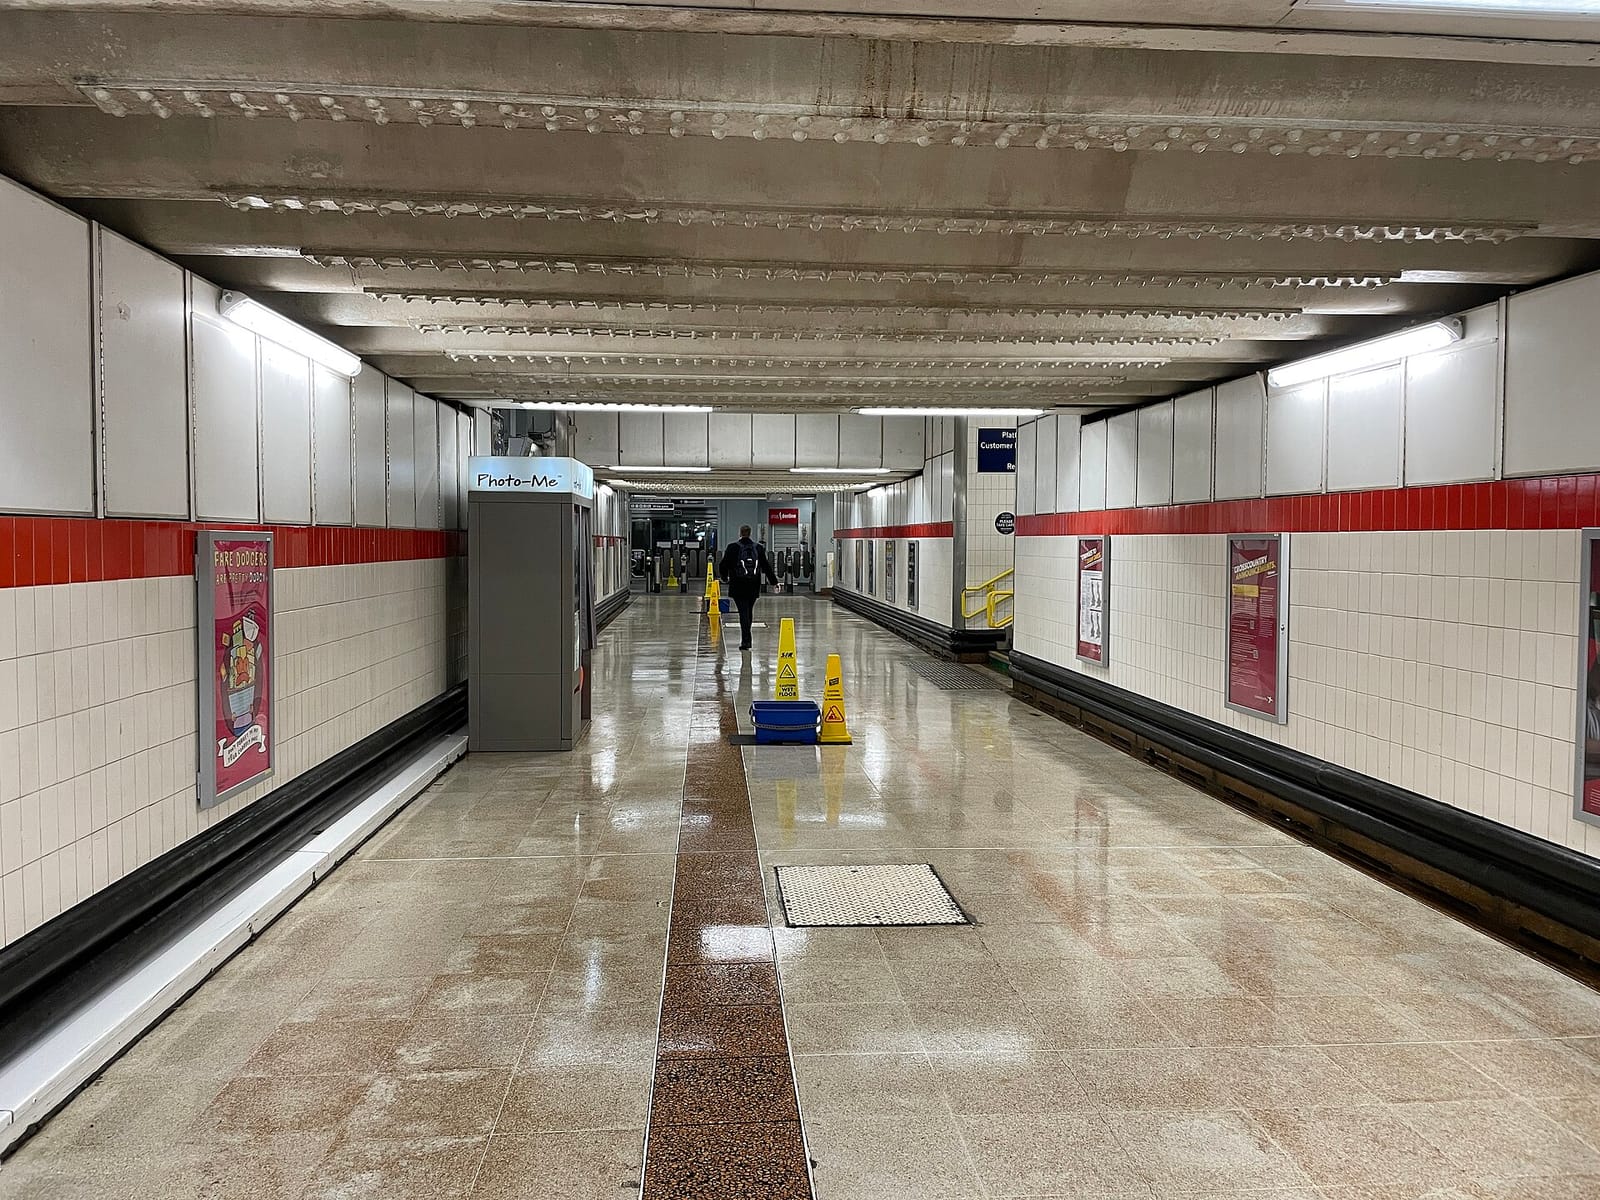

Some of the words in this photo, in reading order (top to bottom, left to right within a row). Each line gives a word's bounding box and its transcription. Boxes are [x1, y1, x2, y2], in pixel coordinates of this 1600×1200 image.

[980, 441, 1013, 449] Customer
[477, 474, 558, 488] Photo-Me
[214, 551, 234, 567] FARE
[236, 551, 268, 568] DODGERS
[1233, 555, 1268, 574] CROSSCOUNTRY
[216, 574, 226, 585] ARE
